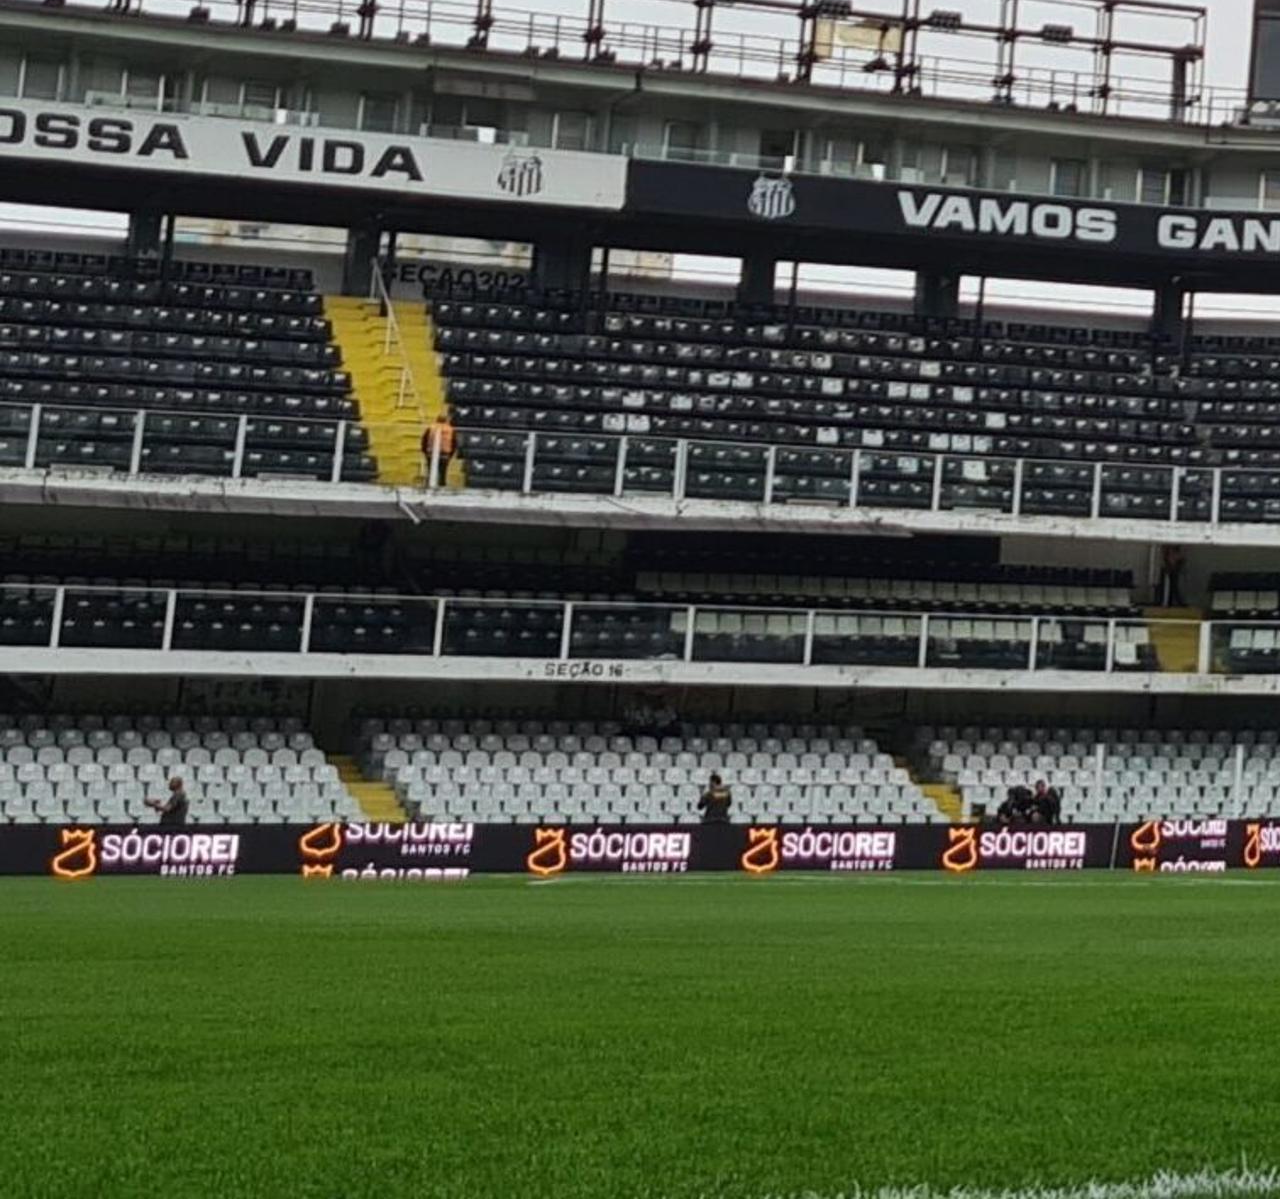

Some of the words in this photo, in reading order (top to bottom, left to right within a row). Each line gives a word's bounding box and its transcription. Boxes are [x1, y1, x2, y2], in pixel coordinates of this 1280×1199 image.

[241, 131, 424, 182] VIDA
[897, 189, 1118, 242] VAMOS
[544, 661, 604, 678] SEÇÃO
[102, 828, 239, 861] SÓCIOREI
[400, 843, 450, 855] SANTOS
[570, 827, 691, 859] SÓCIOREI
[782, 827, 896, 858] SÓCIOREI
[980, 826, 1086, 857] SÓCIOREI
